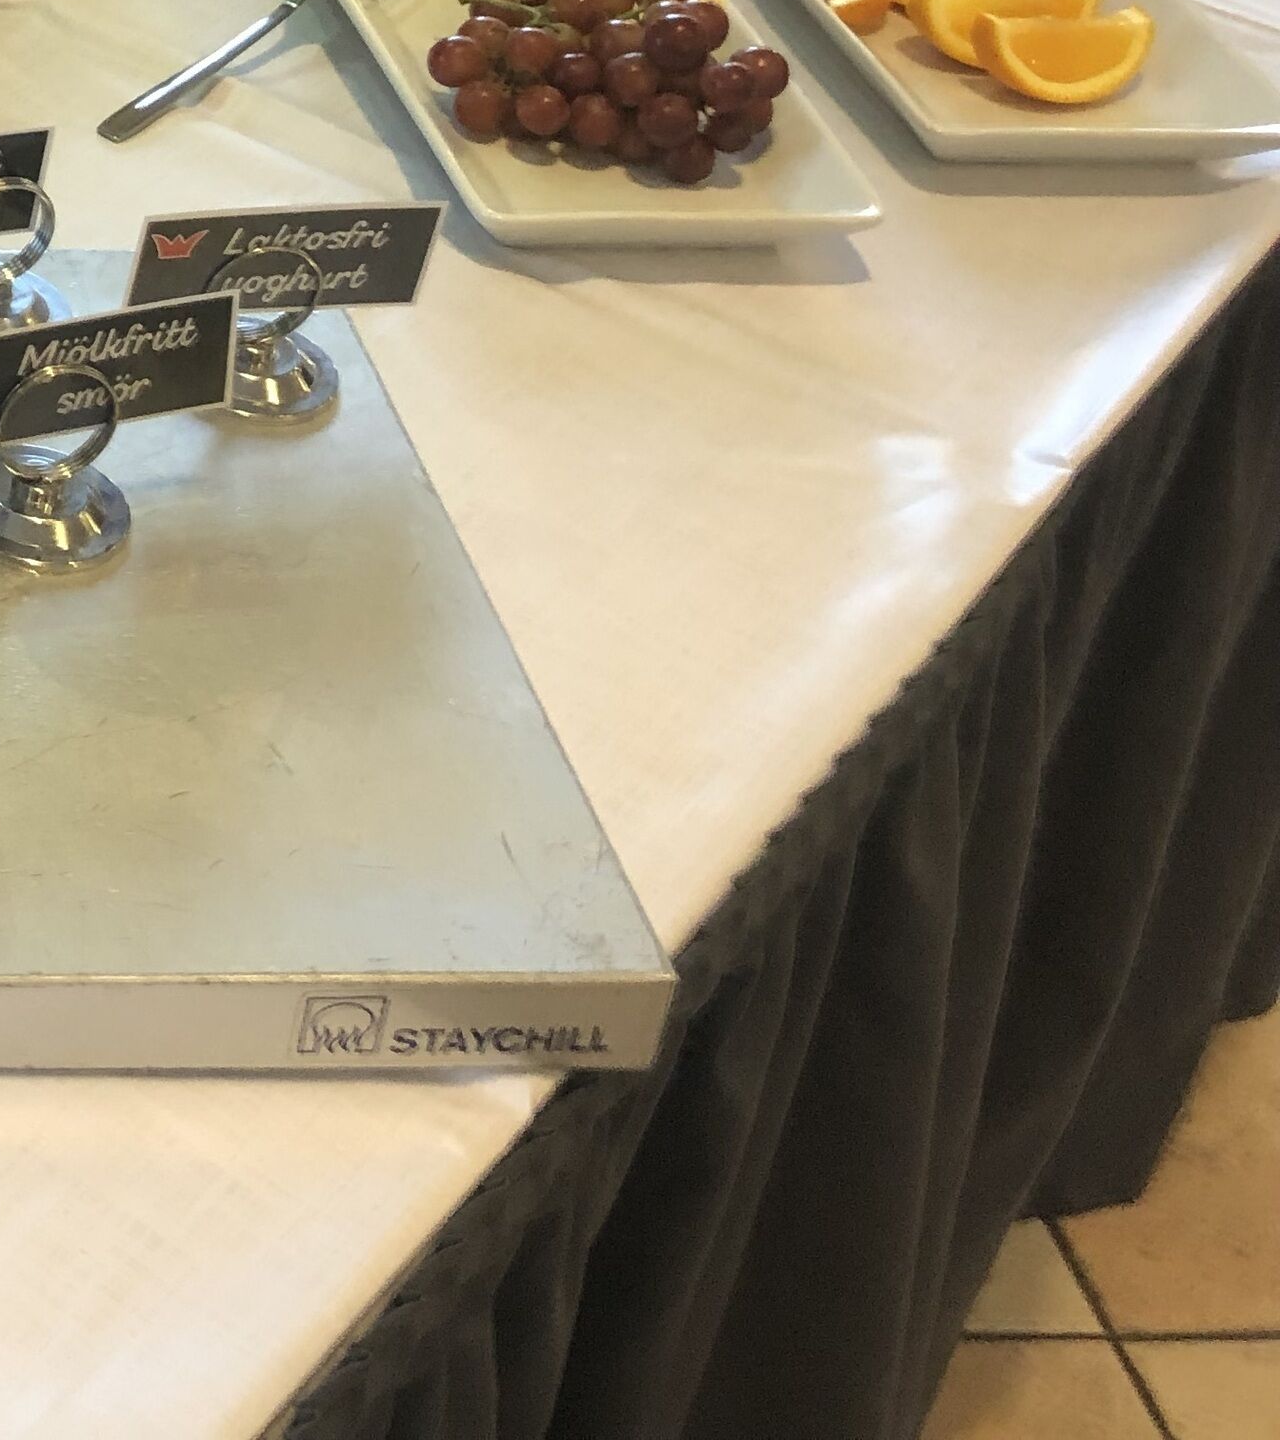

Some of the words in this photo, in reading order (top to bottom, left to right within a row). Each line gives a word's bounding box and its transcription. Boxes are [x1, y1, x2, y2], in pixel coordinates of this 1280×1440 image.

[223, 220, 391, 256] Laktosfri
[56, 374, 152, 415] smör
[389, 1023, 609, 1055] STAYCHILL
